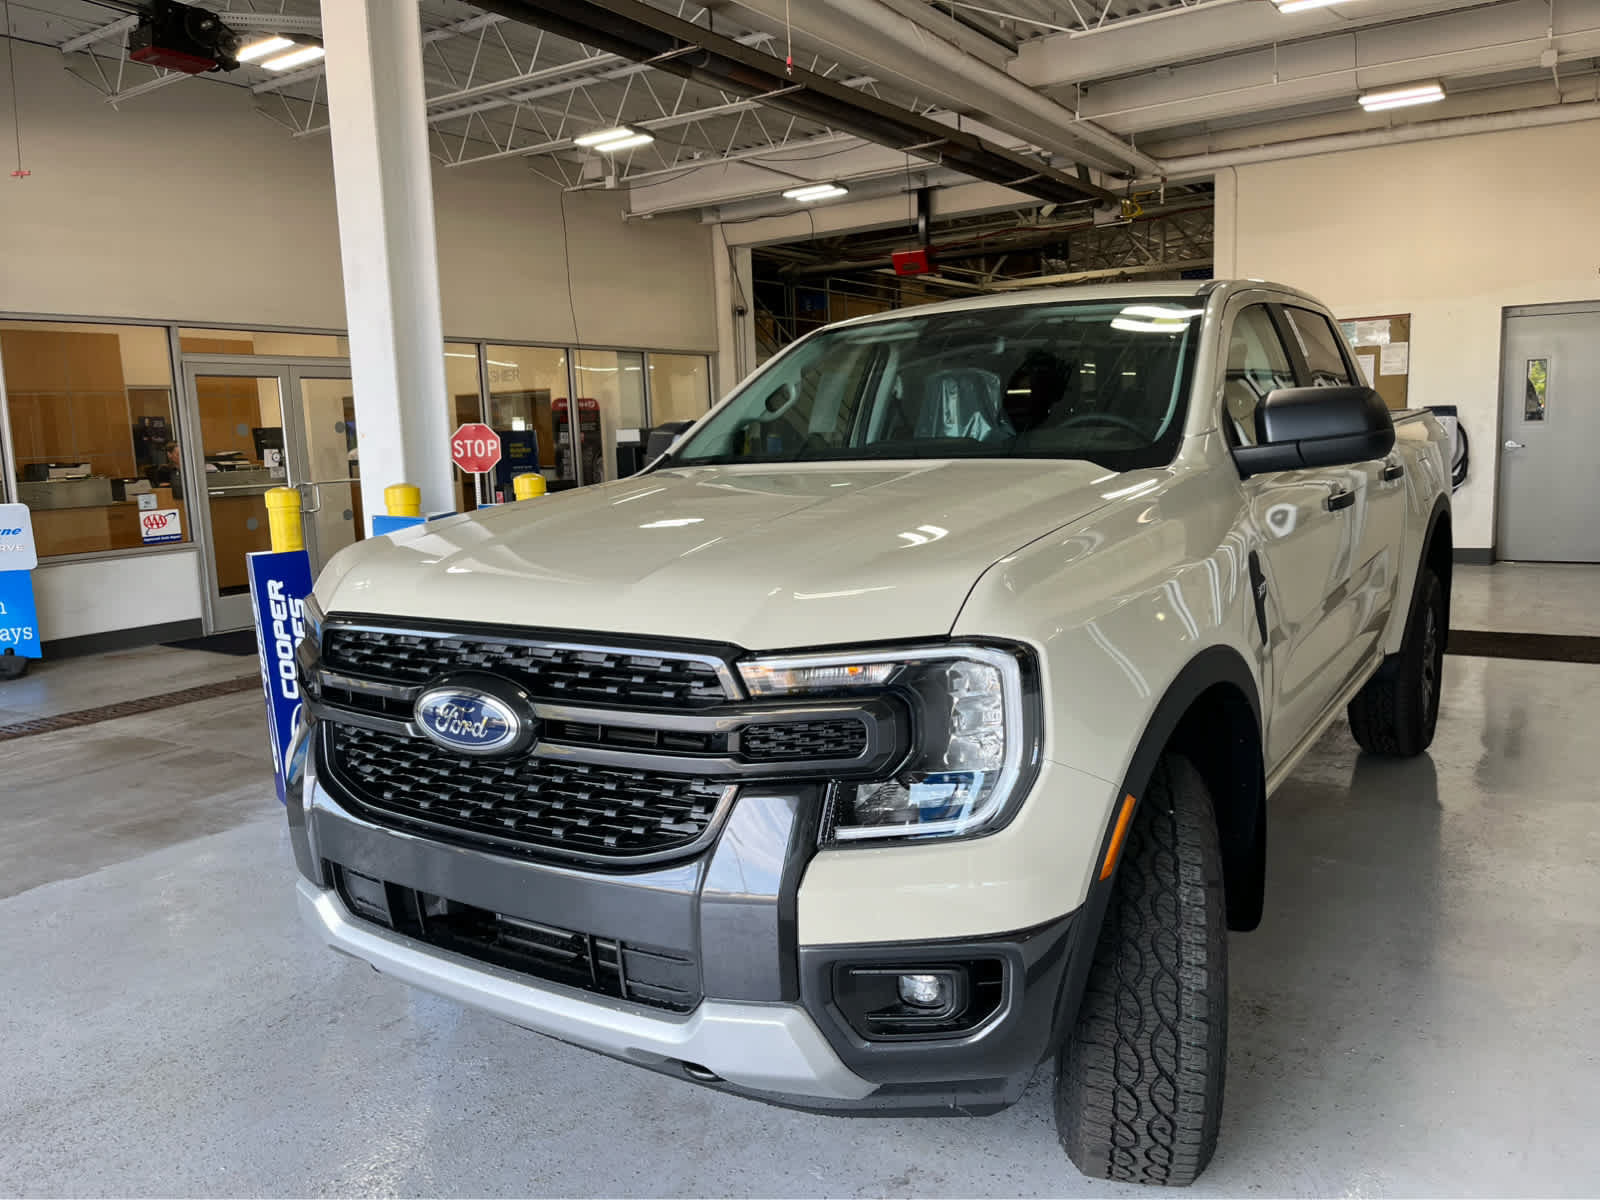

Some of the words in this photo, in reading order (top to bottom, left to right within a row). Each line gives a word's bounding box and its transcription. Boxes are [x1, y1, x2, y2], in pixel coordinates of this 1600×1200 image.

[453, 439, 498, 458] STOP
[143, 514, 168, 529] AAA
[267, 579, 299, 700] COOPER
[435, 702, 488, 738] Ford
